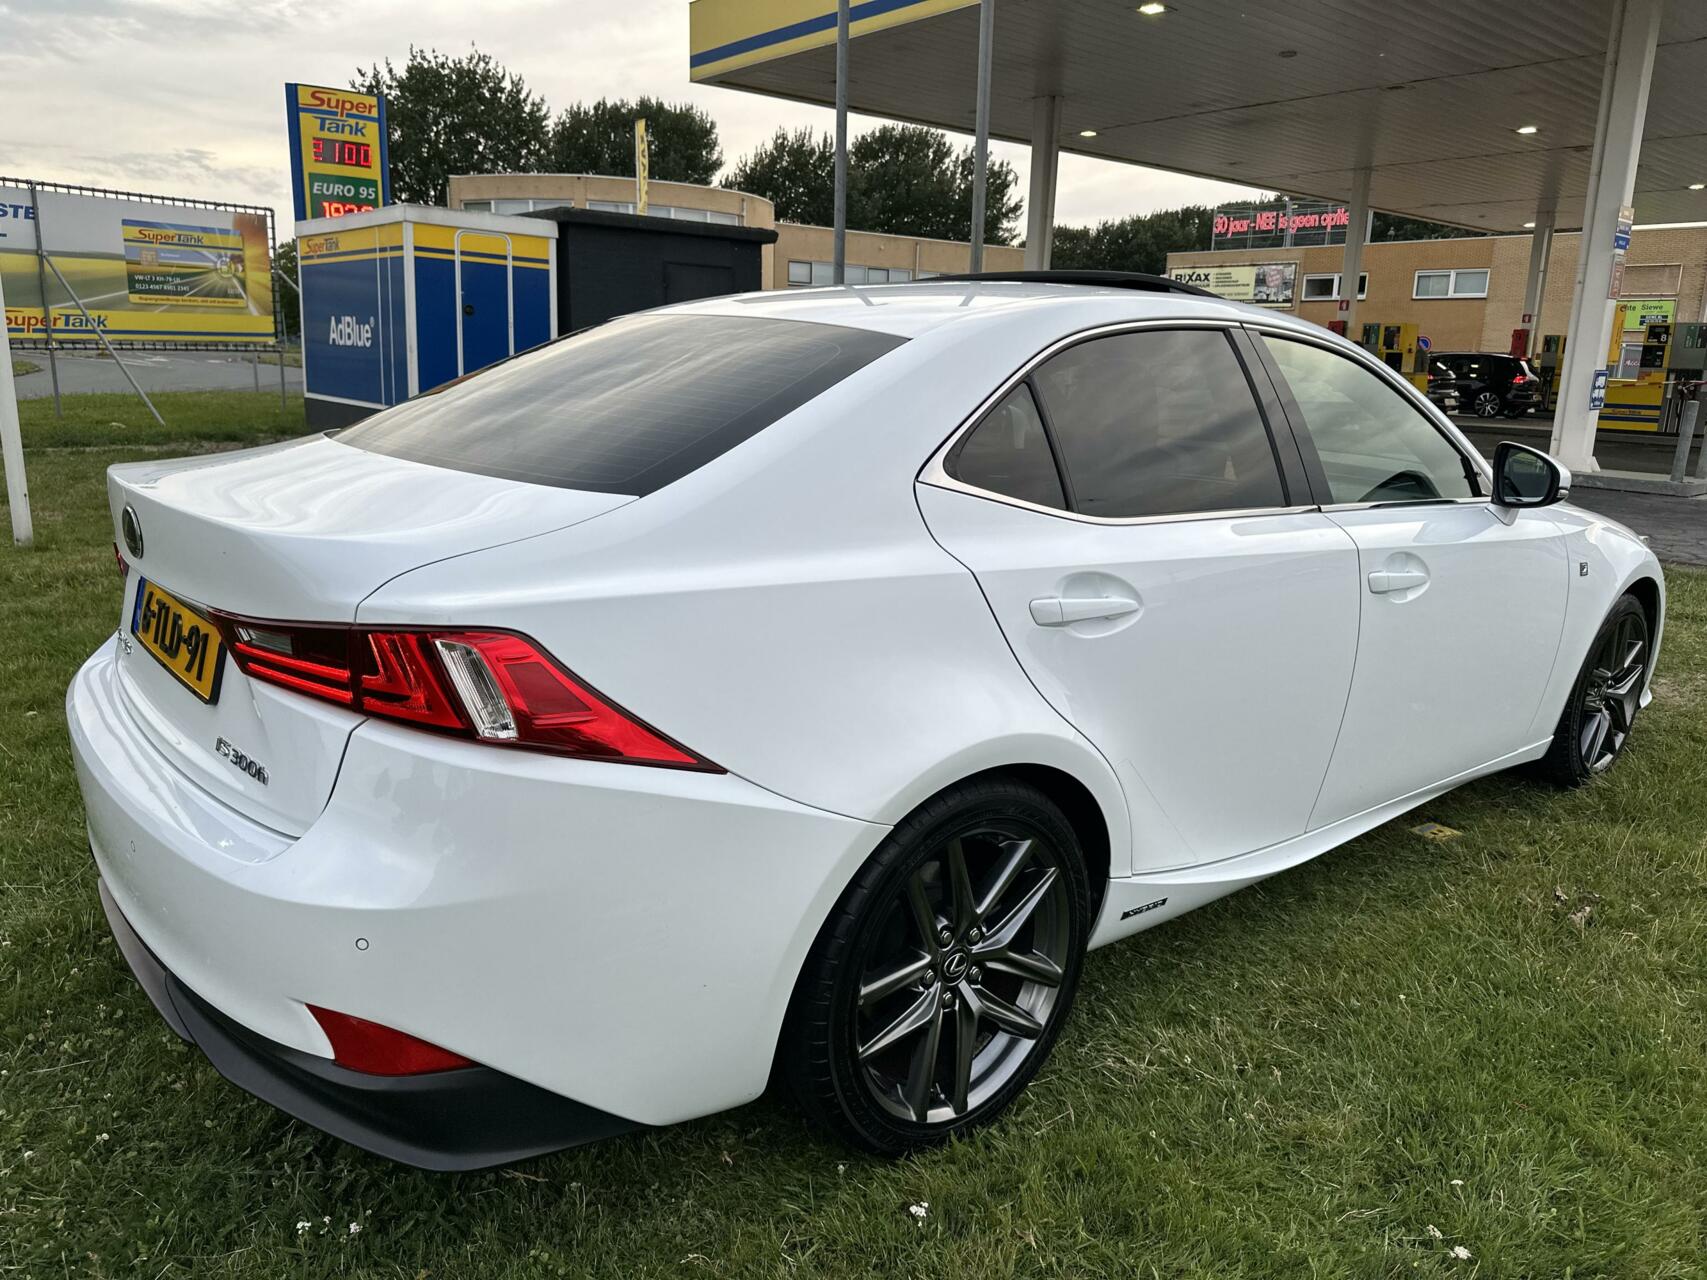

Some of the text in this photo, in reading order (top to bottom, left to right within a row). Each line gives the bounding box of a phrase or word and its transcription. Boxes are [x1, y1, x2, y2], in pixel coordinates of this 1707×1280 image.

[299, 90, 377, 118] Super
[312, 115, 367, 137] Tank
[313, 181, 377, 199] EURO 95
[1660, 334, 1667, 342] 8
[141, 590, 210, 682] 6-TLD-91
[230, 747, 269, 786] 300h
